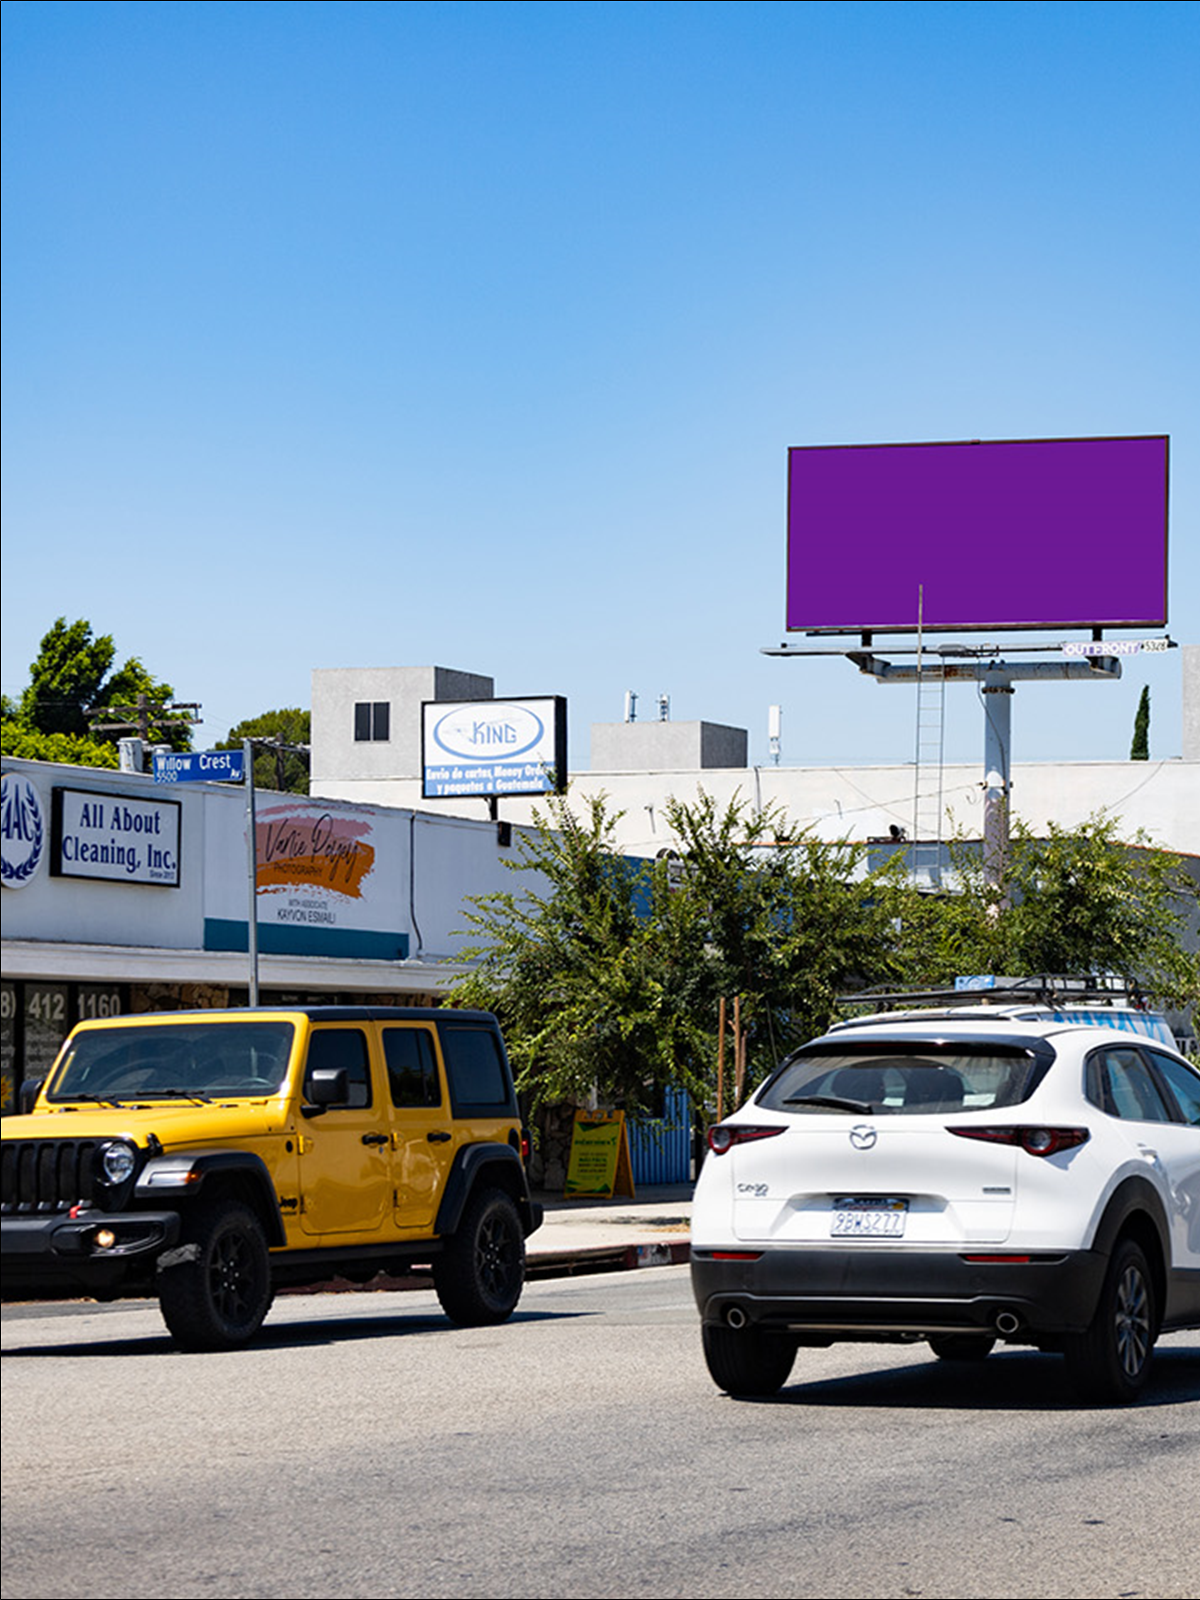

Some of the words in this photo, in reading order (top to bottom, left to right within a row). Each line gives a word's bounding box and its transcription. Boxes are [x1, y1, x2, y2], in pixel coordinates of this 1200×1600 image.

[469, 721, 517, 744] KING
[156, 757, 191, 770] Willow
[199, 754, 231, 770] Crest
[80, 803, 104, 829] All
[110, 806, 161, 835] About
[62, 835, 141, 874] Cleaning,
[147, 844, 176, 869] Inc.
[29, 992, 65, 1019] 412
[78, 994, 121, 1019] 1160
